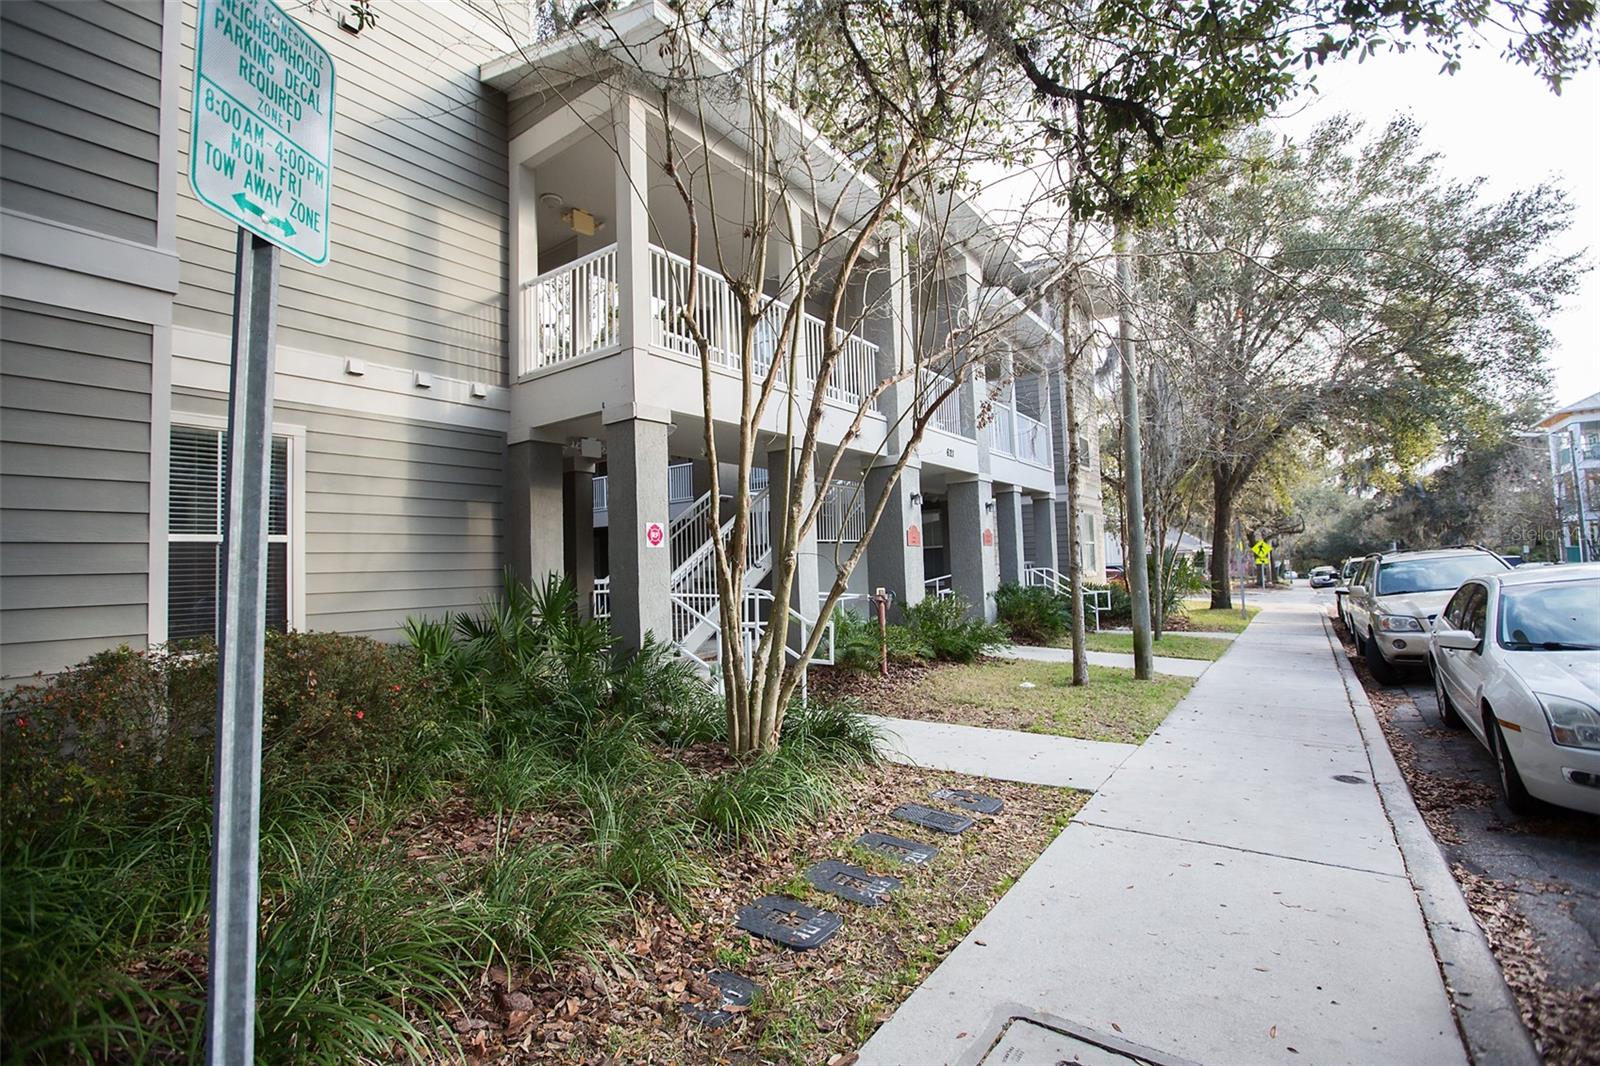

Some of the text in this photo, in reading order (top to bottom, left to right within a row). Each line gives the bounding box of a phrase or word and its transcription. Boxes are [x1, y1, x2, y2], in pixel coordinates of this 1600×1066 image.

[214, 8, 322, 115] PARKING DECAL
[264, 6, 324, 70] GNESVILLE
[239, 55, 302, 121] REQUIRED
[257, 98, 292, 134] ZONE 1
[204, 140, 321, 233] TOW AWAY ZONE
[231, 133, 264, 173] MON
[279, 168, 302, 198] FRI
